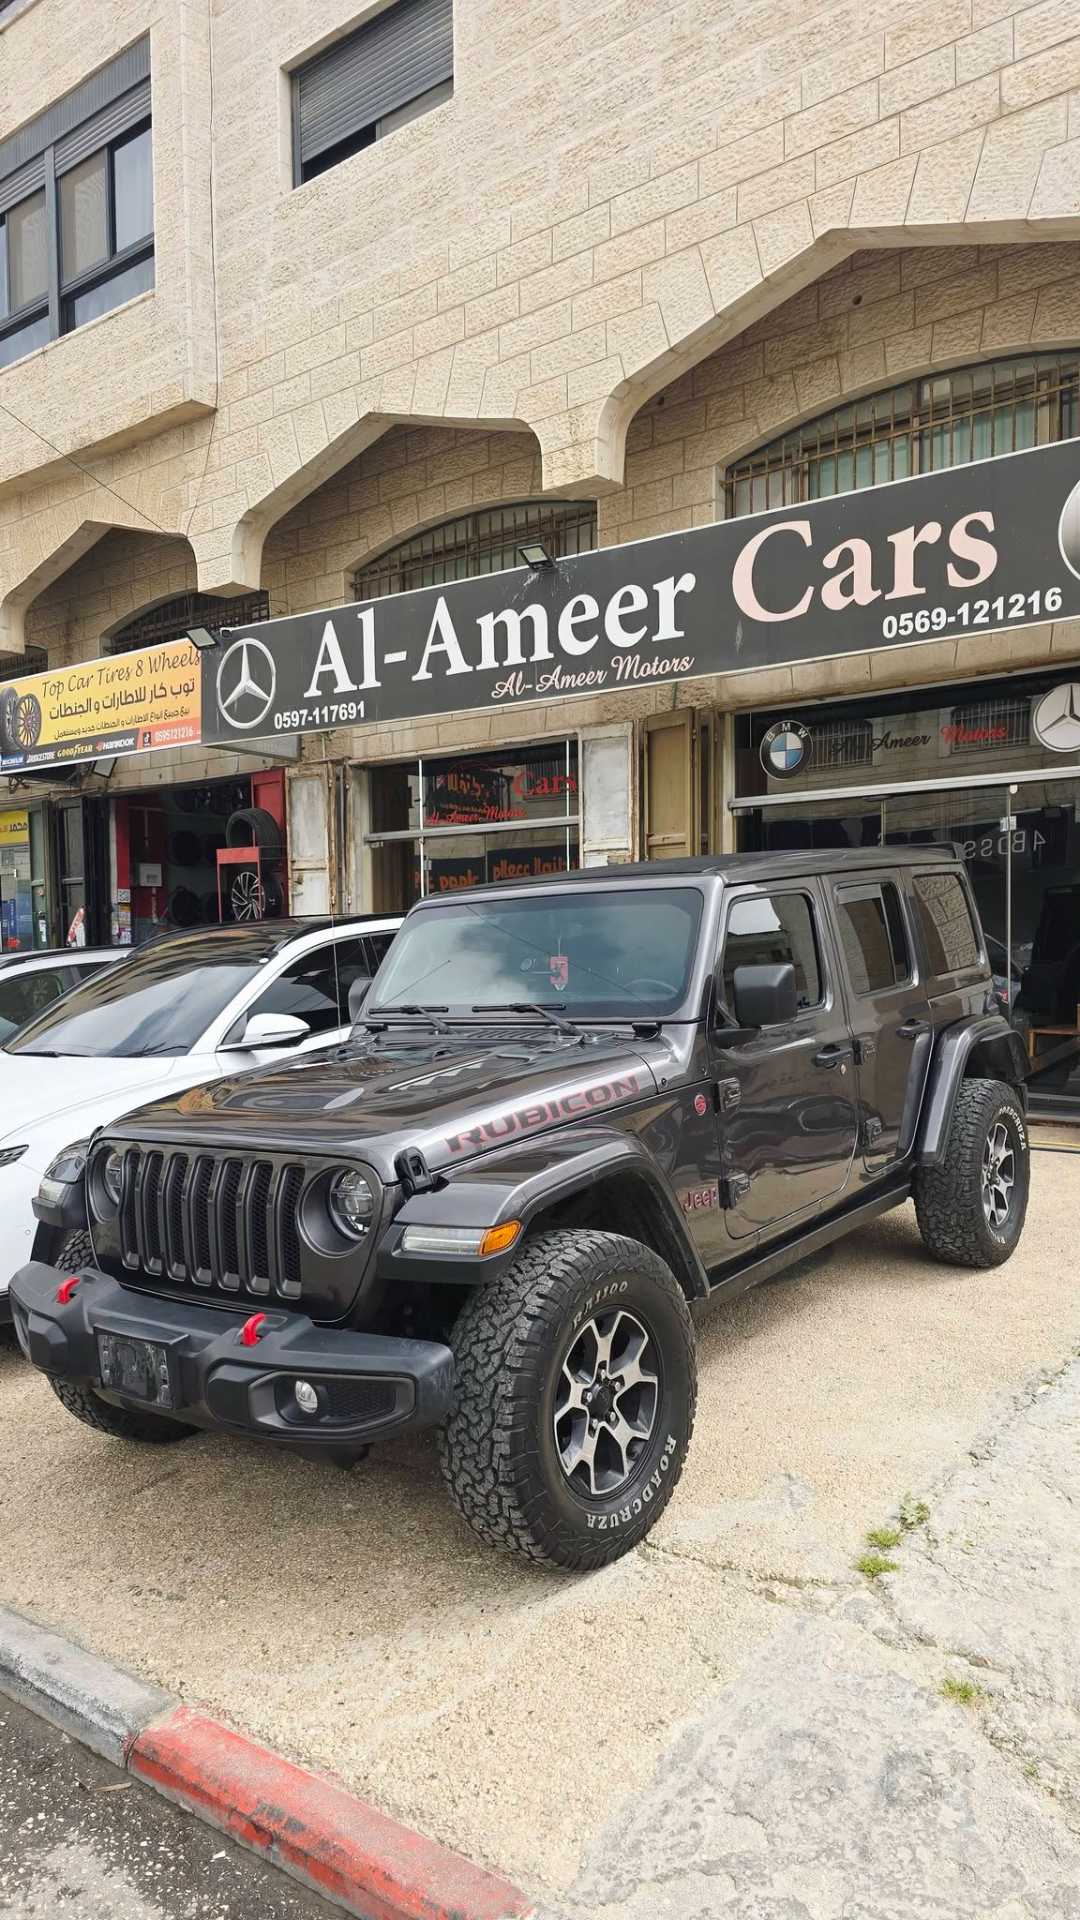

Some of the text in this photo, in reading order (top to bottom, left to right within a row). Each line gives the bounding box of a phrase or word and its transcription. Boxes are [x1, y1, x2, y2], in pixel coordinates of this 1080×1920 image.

[304, 511, 998, 698] Al-Ameer Cars
[882, 586, 1063, 639] 0569-121216
[42, 680, 64, 699] Top
[68, 674, 94, 692] Car
[97, 667, 132, 688] Tires
[148, 646, 201, 674] Wheels
[611, 654, 696, 681] Motors
[149, 682, 167, 704] كار
[171, 678, 195, 697] توب
[274, 700, 366, 731] 0597-117691
[57, 743, 93, 758] GOODYEAR
[445, 1075, 640, 1153] RUBICON
[683, 1186, 718, 1213] Jeep
[585, 1434, 677, 1531] ROADCRUZA
